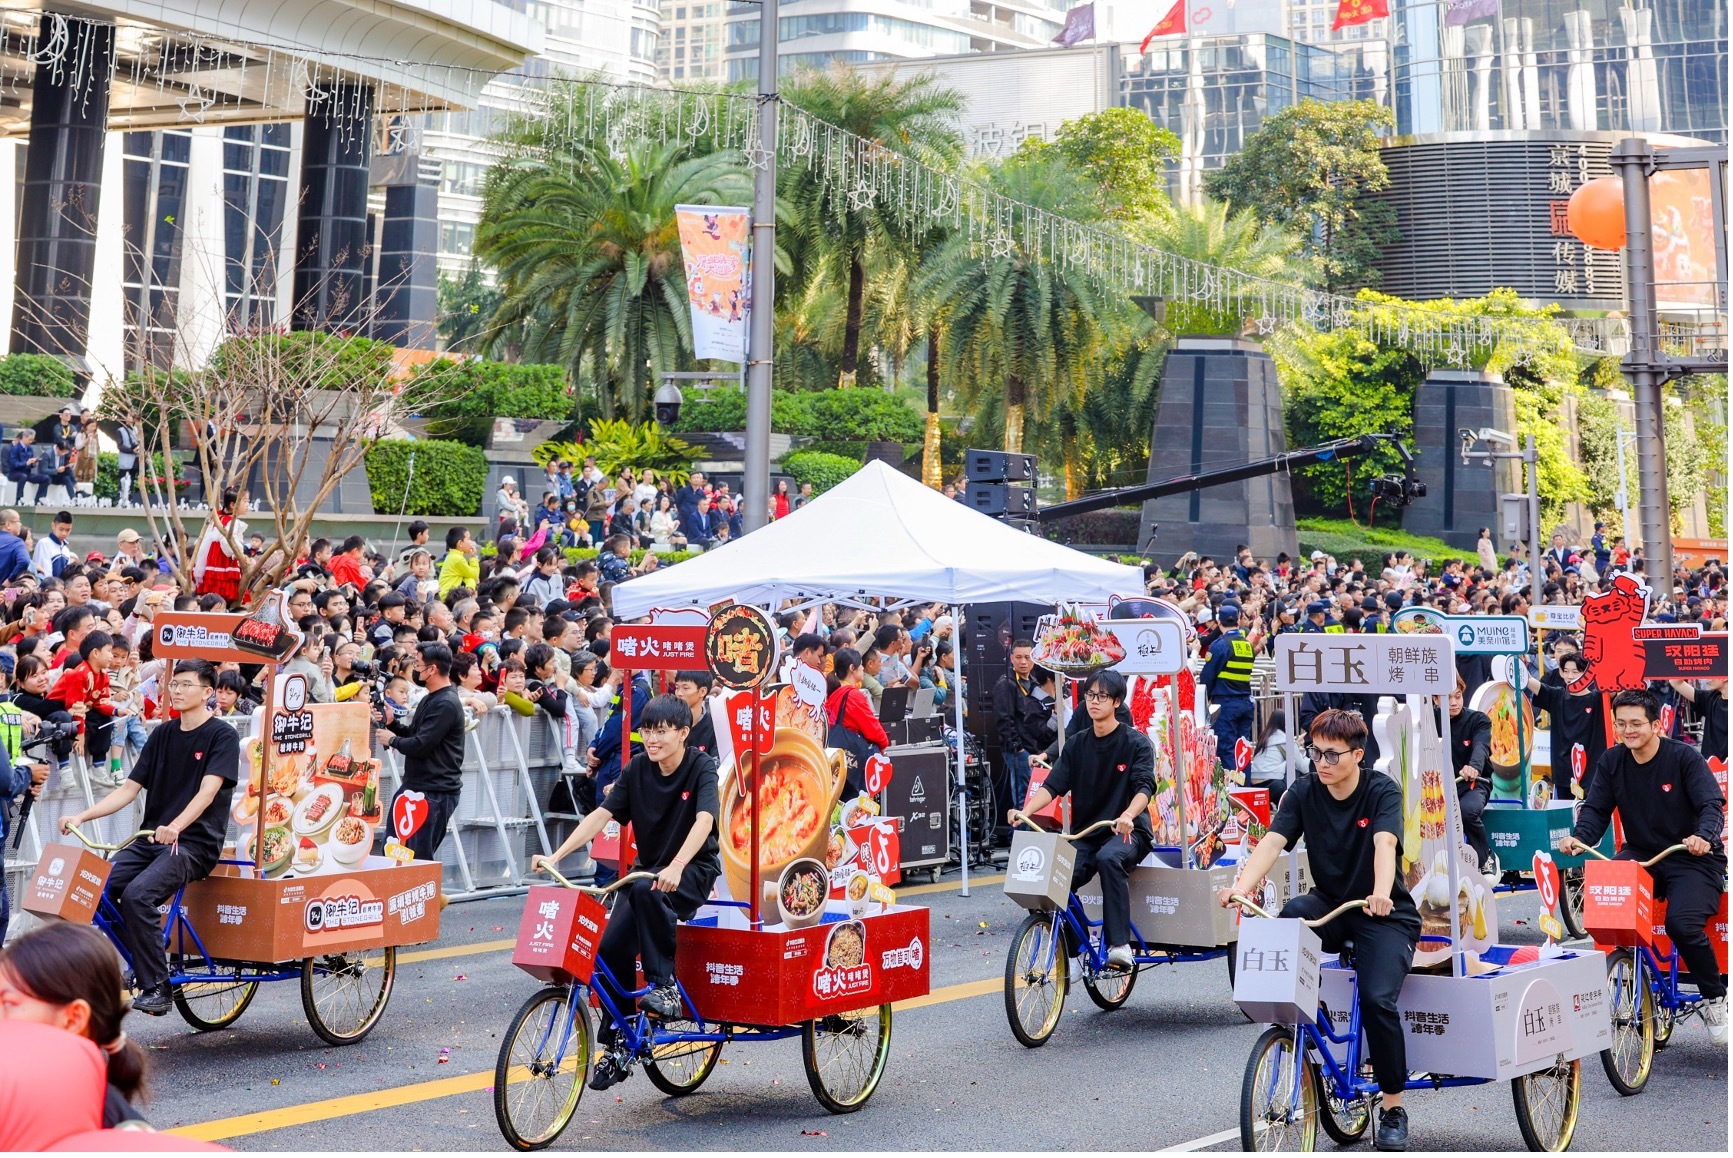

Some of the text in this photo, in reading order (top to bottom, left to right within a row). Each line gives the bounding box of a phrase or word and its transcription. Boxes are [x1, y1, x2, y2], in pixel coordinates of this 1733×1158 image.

[176, 627, 206, 640] 御牛纪
[1635, 628, 1698, 639] SUPER HAYACO
[1288, 641, 1370, 685] 白玉
[1388, 647, 1438, 665] 朝鲜族
[274, 712, 312, 733] 御牛纪
[391, 845, 410, 860] 2026
[874, 885, 893, 901] 2026
[1145, 895, 1180, 906] 抖音生活
[217, 904, 247, 915] 抖音生活
[325, 901, 358, 917] 御牛纪
[1544, 917, 1560, 935] 2026
[1242, 947, 1290, 972] 白玉
[705, 961, 744, 976] 抖音生活
[1404, 1010, 1450, 1025] 抖音生活
[1524, 1006, 1546, 1037] 白玉
[1411, 1023, 1446, 1036] 跨年季
